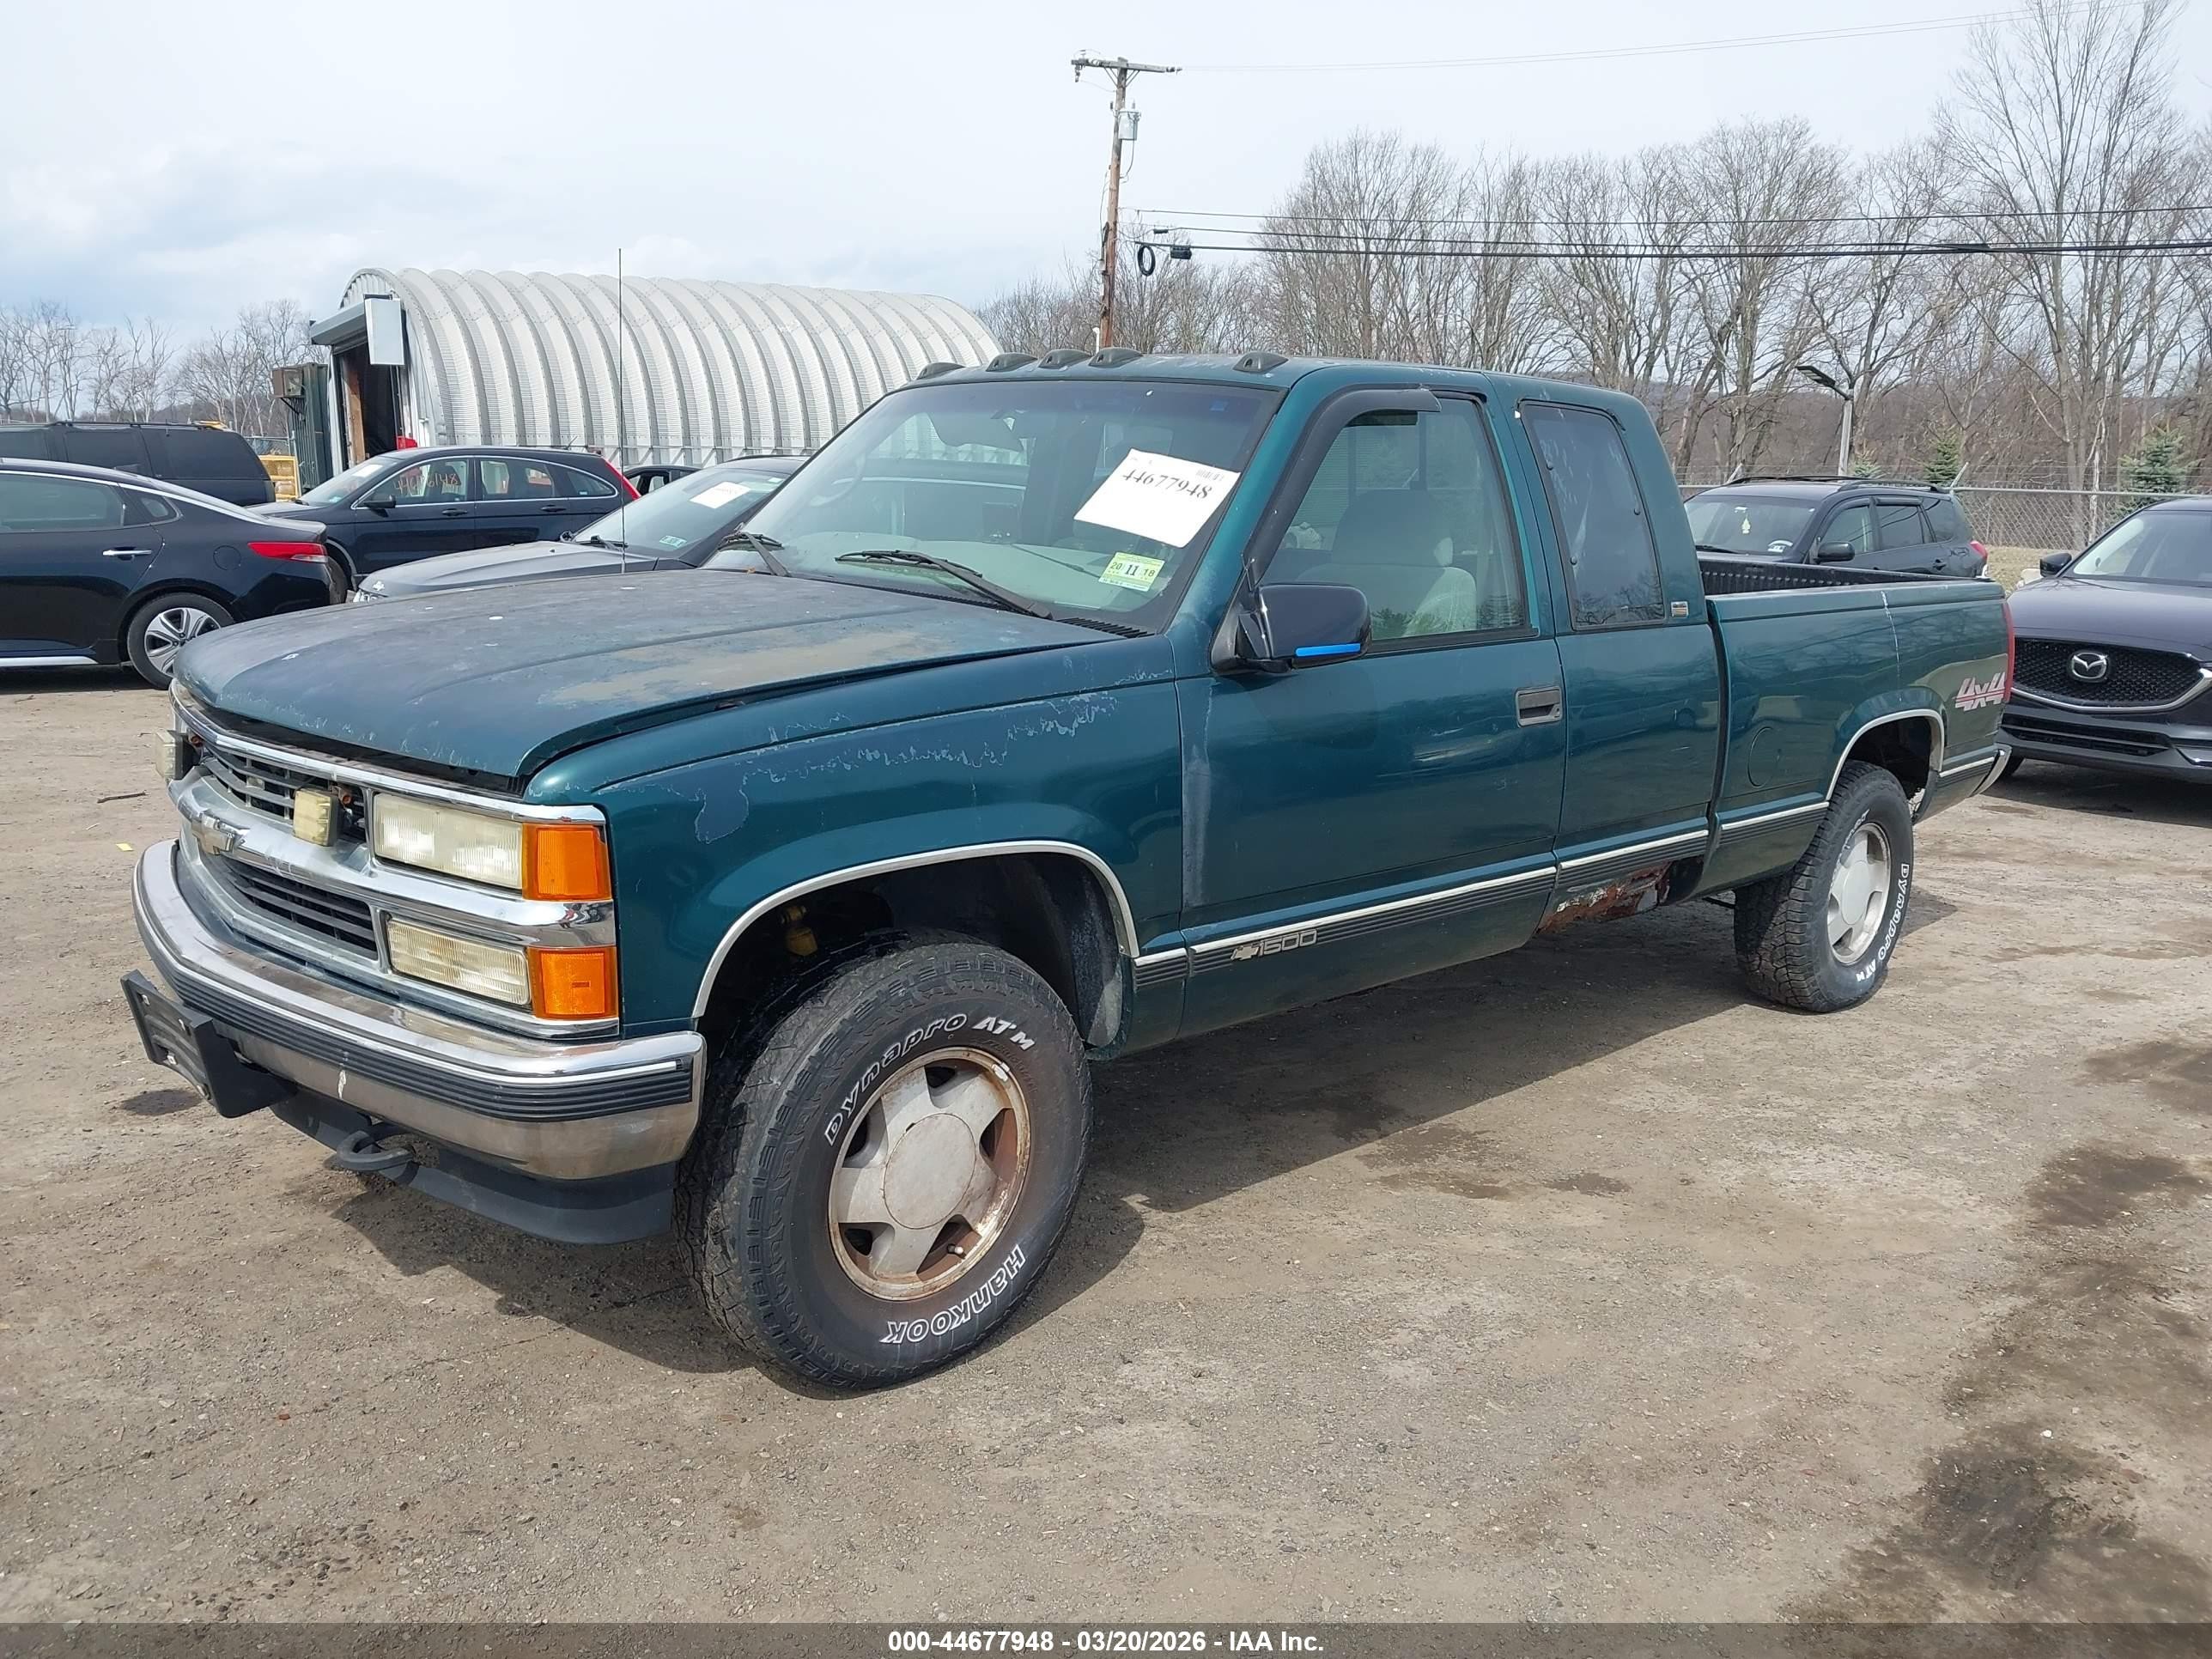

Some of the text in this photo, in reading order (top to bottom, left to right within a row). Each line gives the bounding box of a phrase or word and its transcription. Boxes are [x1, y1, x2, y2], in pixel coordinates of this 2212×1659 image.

[1122, 469, 1212, 498] 44677948
[1110, 562, 1156, 577] 20 11 18
[1955, 672, 2006, 712] 4x4
[1258, 928, 1317, 957] 1500
[824, 1013, 968, 1146] Dynapro
